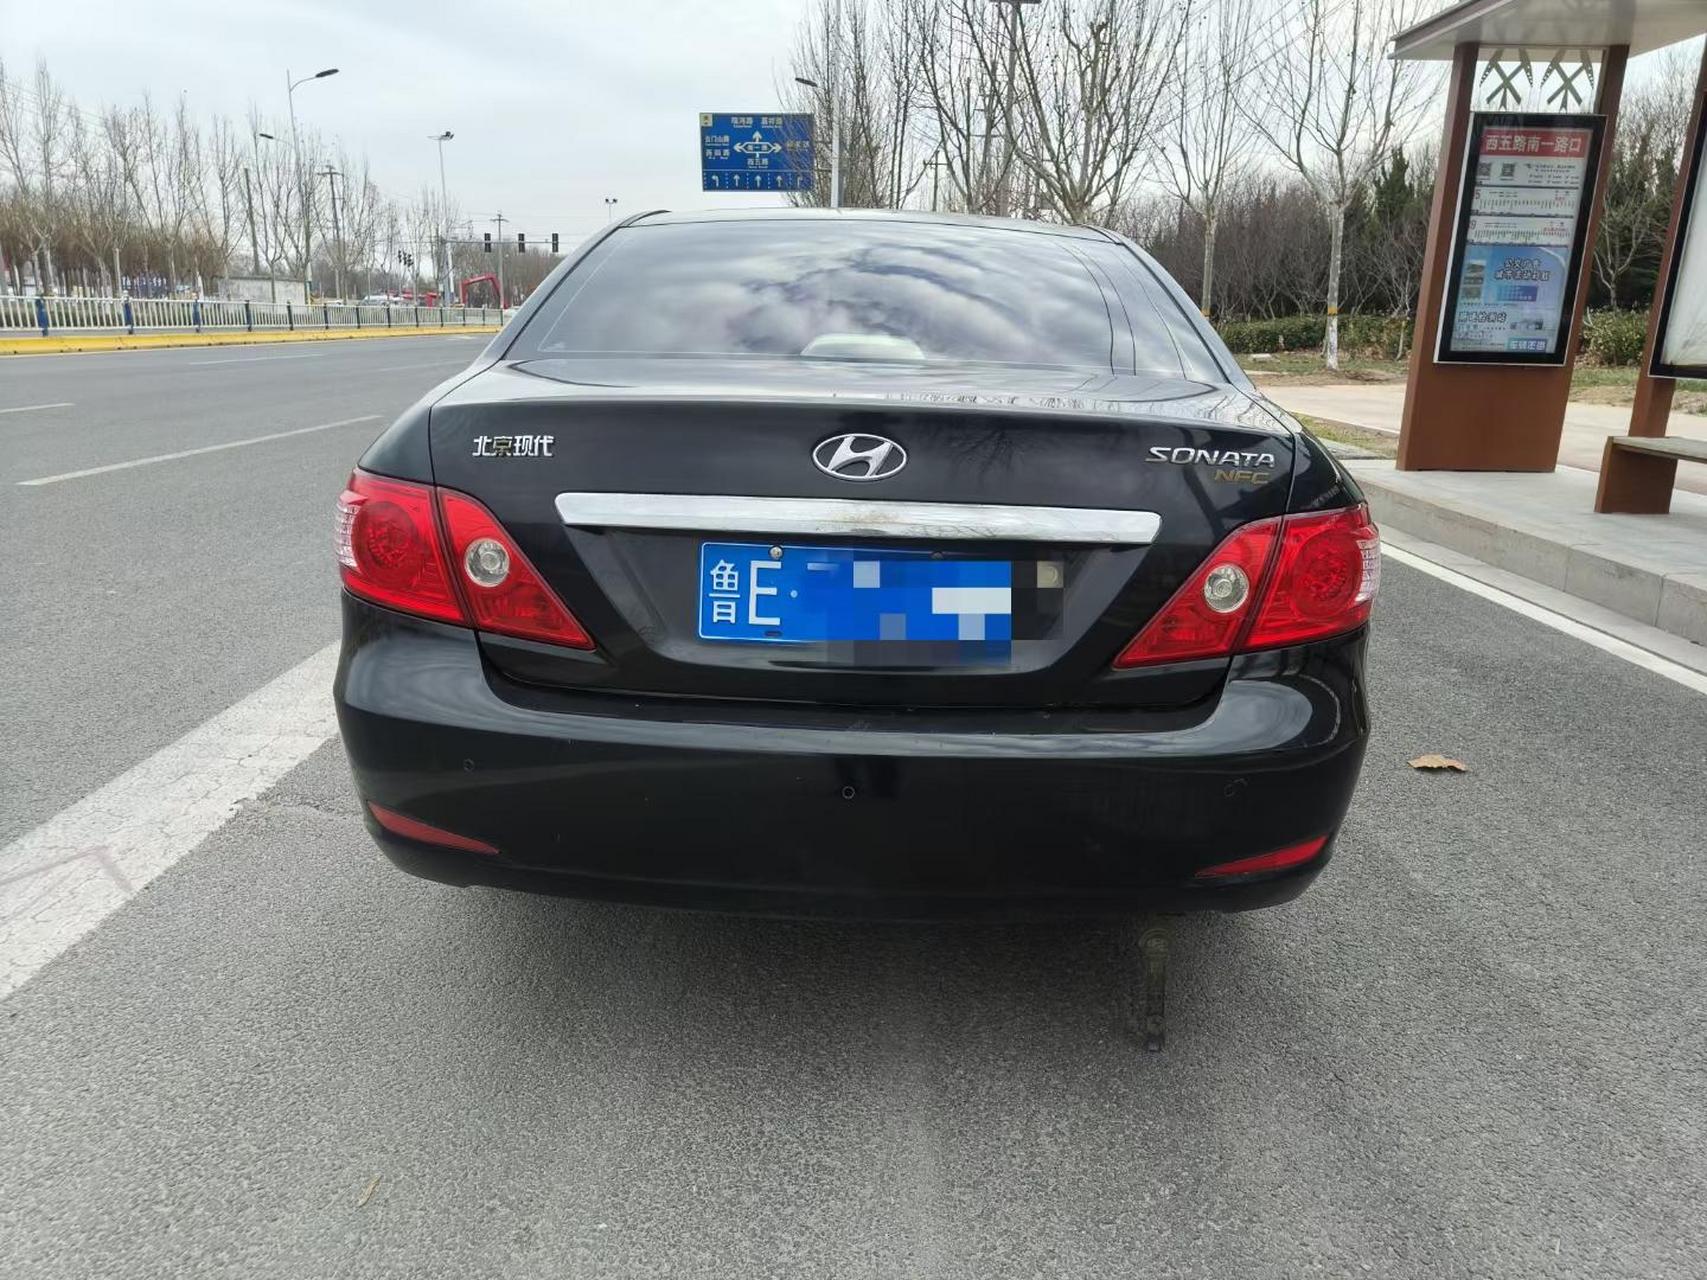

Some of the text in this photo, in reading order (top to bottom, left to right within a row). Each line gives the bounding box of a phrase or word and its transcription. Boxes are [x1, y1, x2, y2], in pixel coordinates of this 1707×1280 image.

[1485, 134, 1582, 153] 西五路南一路口
[472, 434, 555, 457] 北京现代
[1145, 446, 1276, 469] SONATA
[1213, 469, 1270, 485] NFC
